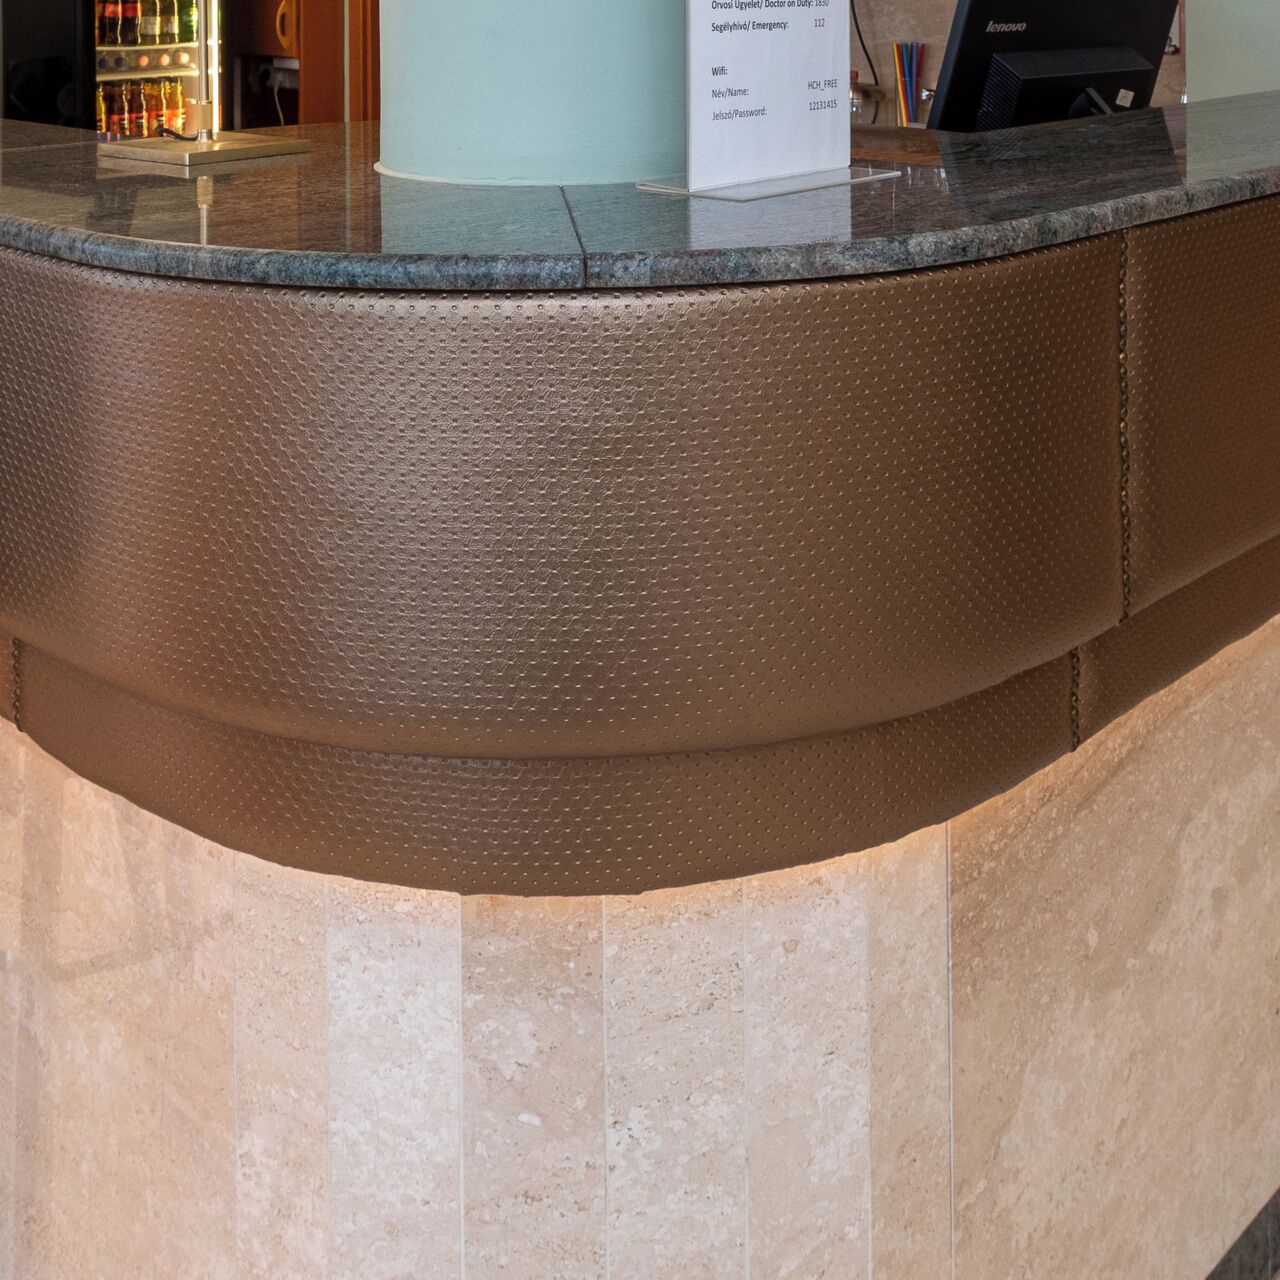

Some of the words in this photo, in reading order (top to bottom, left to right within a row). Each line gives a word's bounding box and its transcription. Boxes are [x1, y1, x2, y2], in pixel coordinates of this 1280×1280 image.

[711, 0, 734, 10] Orvosi
[787, 0, 796, 8] on
[752, 20, 789, 32] Emergency:
[814, 18, 826, 28] 112
[985, 20, 1027, 32] lenovo
[711, 65, 728, 77] Wifi:
[807, 78, 838, 91] HCH_FREE
[809, 99, 838, 111] 12131415
